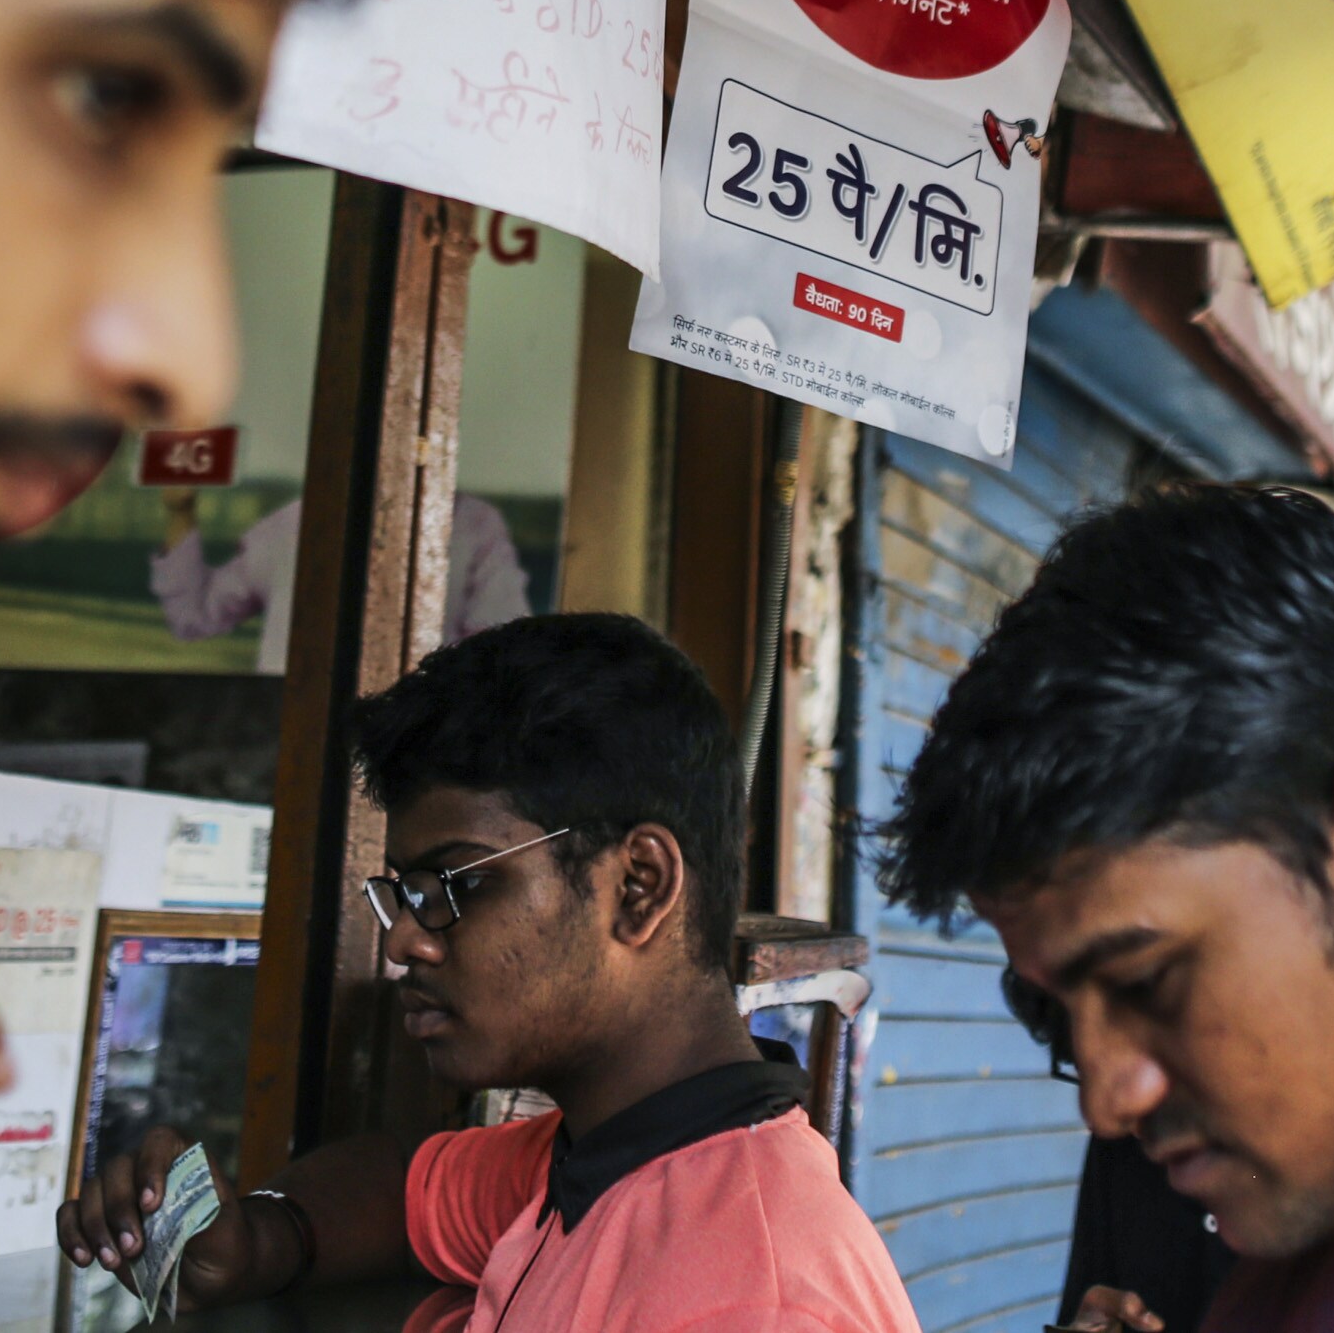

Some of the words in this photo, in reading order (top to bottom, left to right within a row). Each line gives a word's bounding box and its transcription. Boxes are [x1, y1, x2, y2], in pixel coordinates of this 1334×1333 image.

[721, 131, 810, 218] 25
[825, 142, 985, 288] पै/मि.
[804, 282, 844, 316] वैधता:
[847, 305, 868, 324] 90
[870, 309, 895, 333] दिन
[670, 334, 689, 352] और
[690, 342, 706, 358] SR
[735, 357, 750, 371] 25
[781, 371, 804, 389] STD
[785, 353, 801, 369] SR
[828, 368, 842, 383] 25
[871, 380, 899, 401] लोकल
[165, 439, 213, 474] 4G
